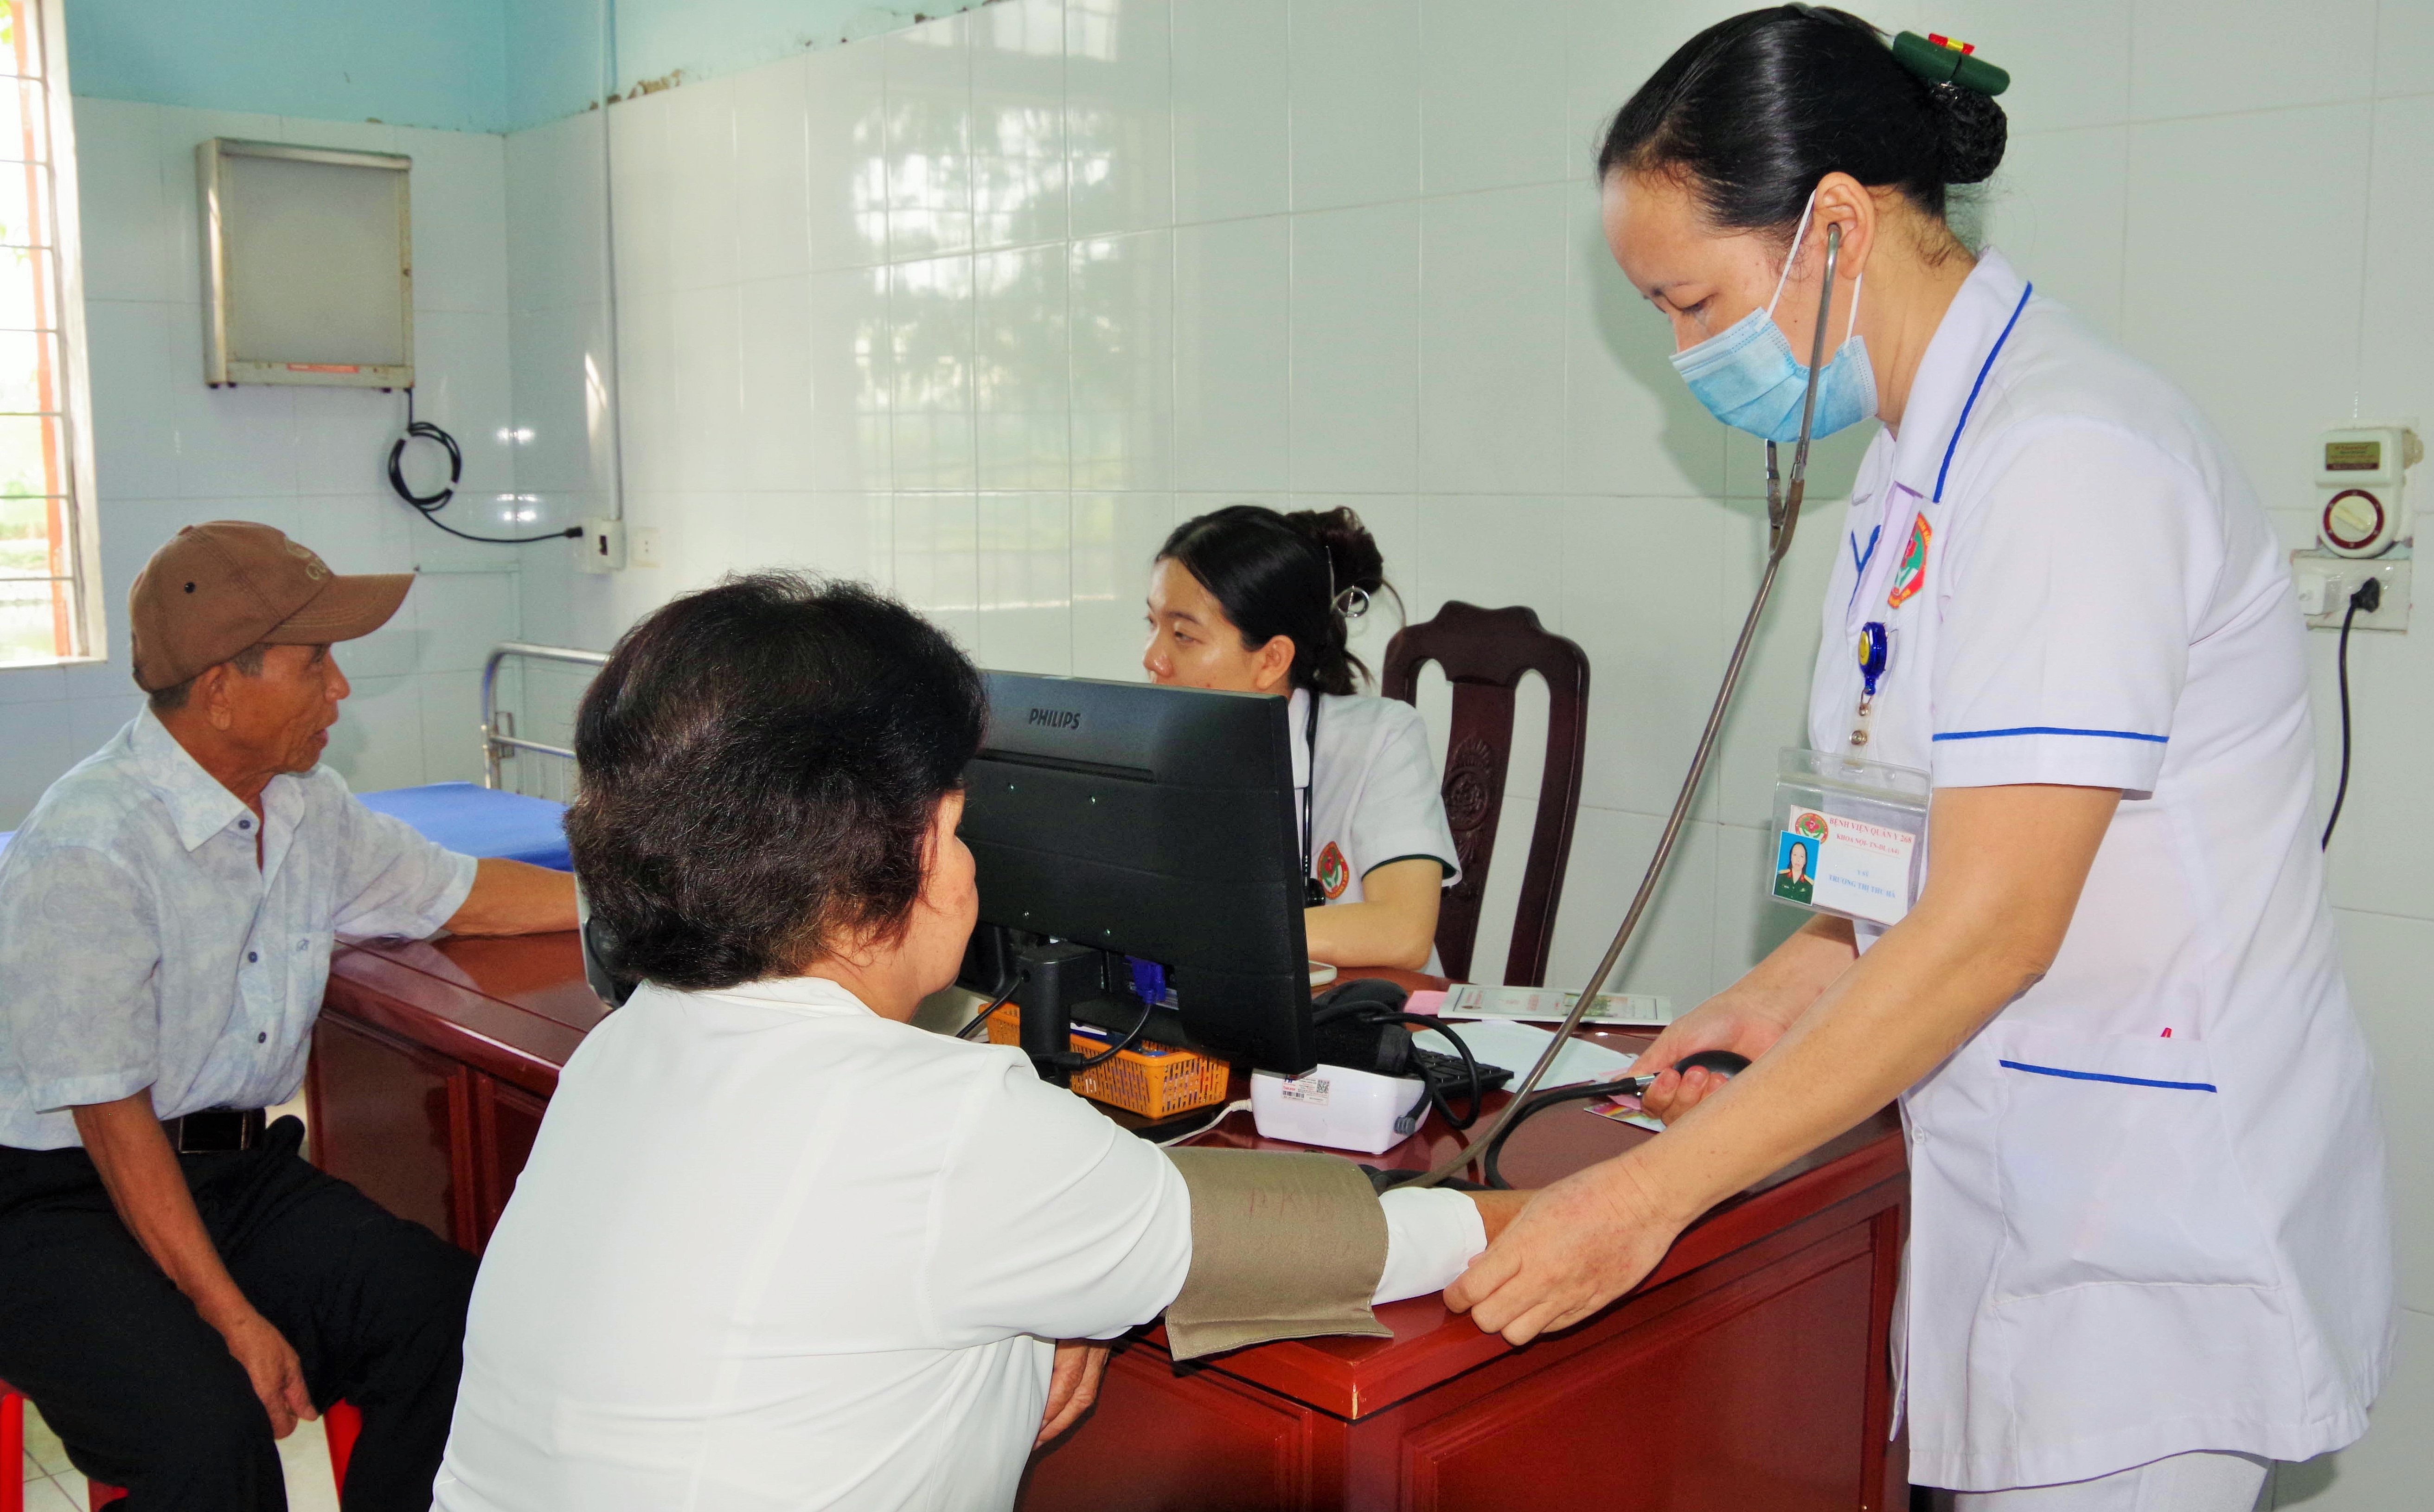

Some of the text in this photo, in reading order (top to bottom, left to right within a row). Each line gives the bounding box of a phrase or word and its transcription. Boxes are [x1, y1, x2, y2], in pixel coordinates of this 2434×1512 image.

[1029, 708, 1081, 730] PHILIPS
[1830, 817, 1849, 828] BỆNH
[1851, 822, 1869, 833] VIỆN
[1900, 835, 1912, 843] 268
